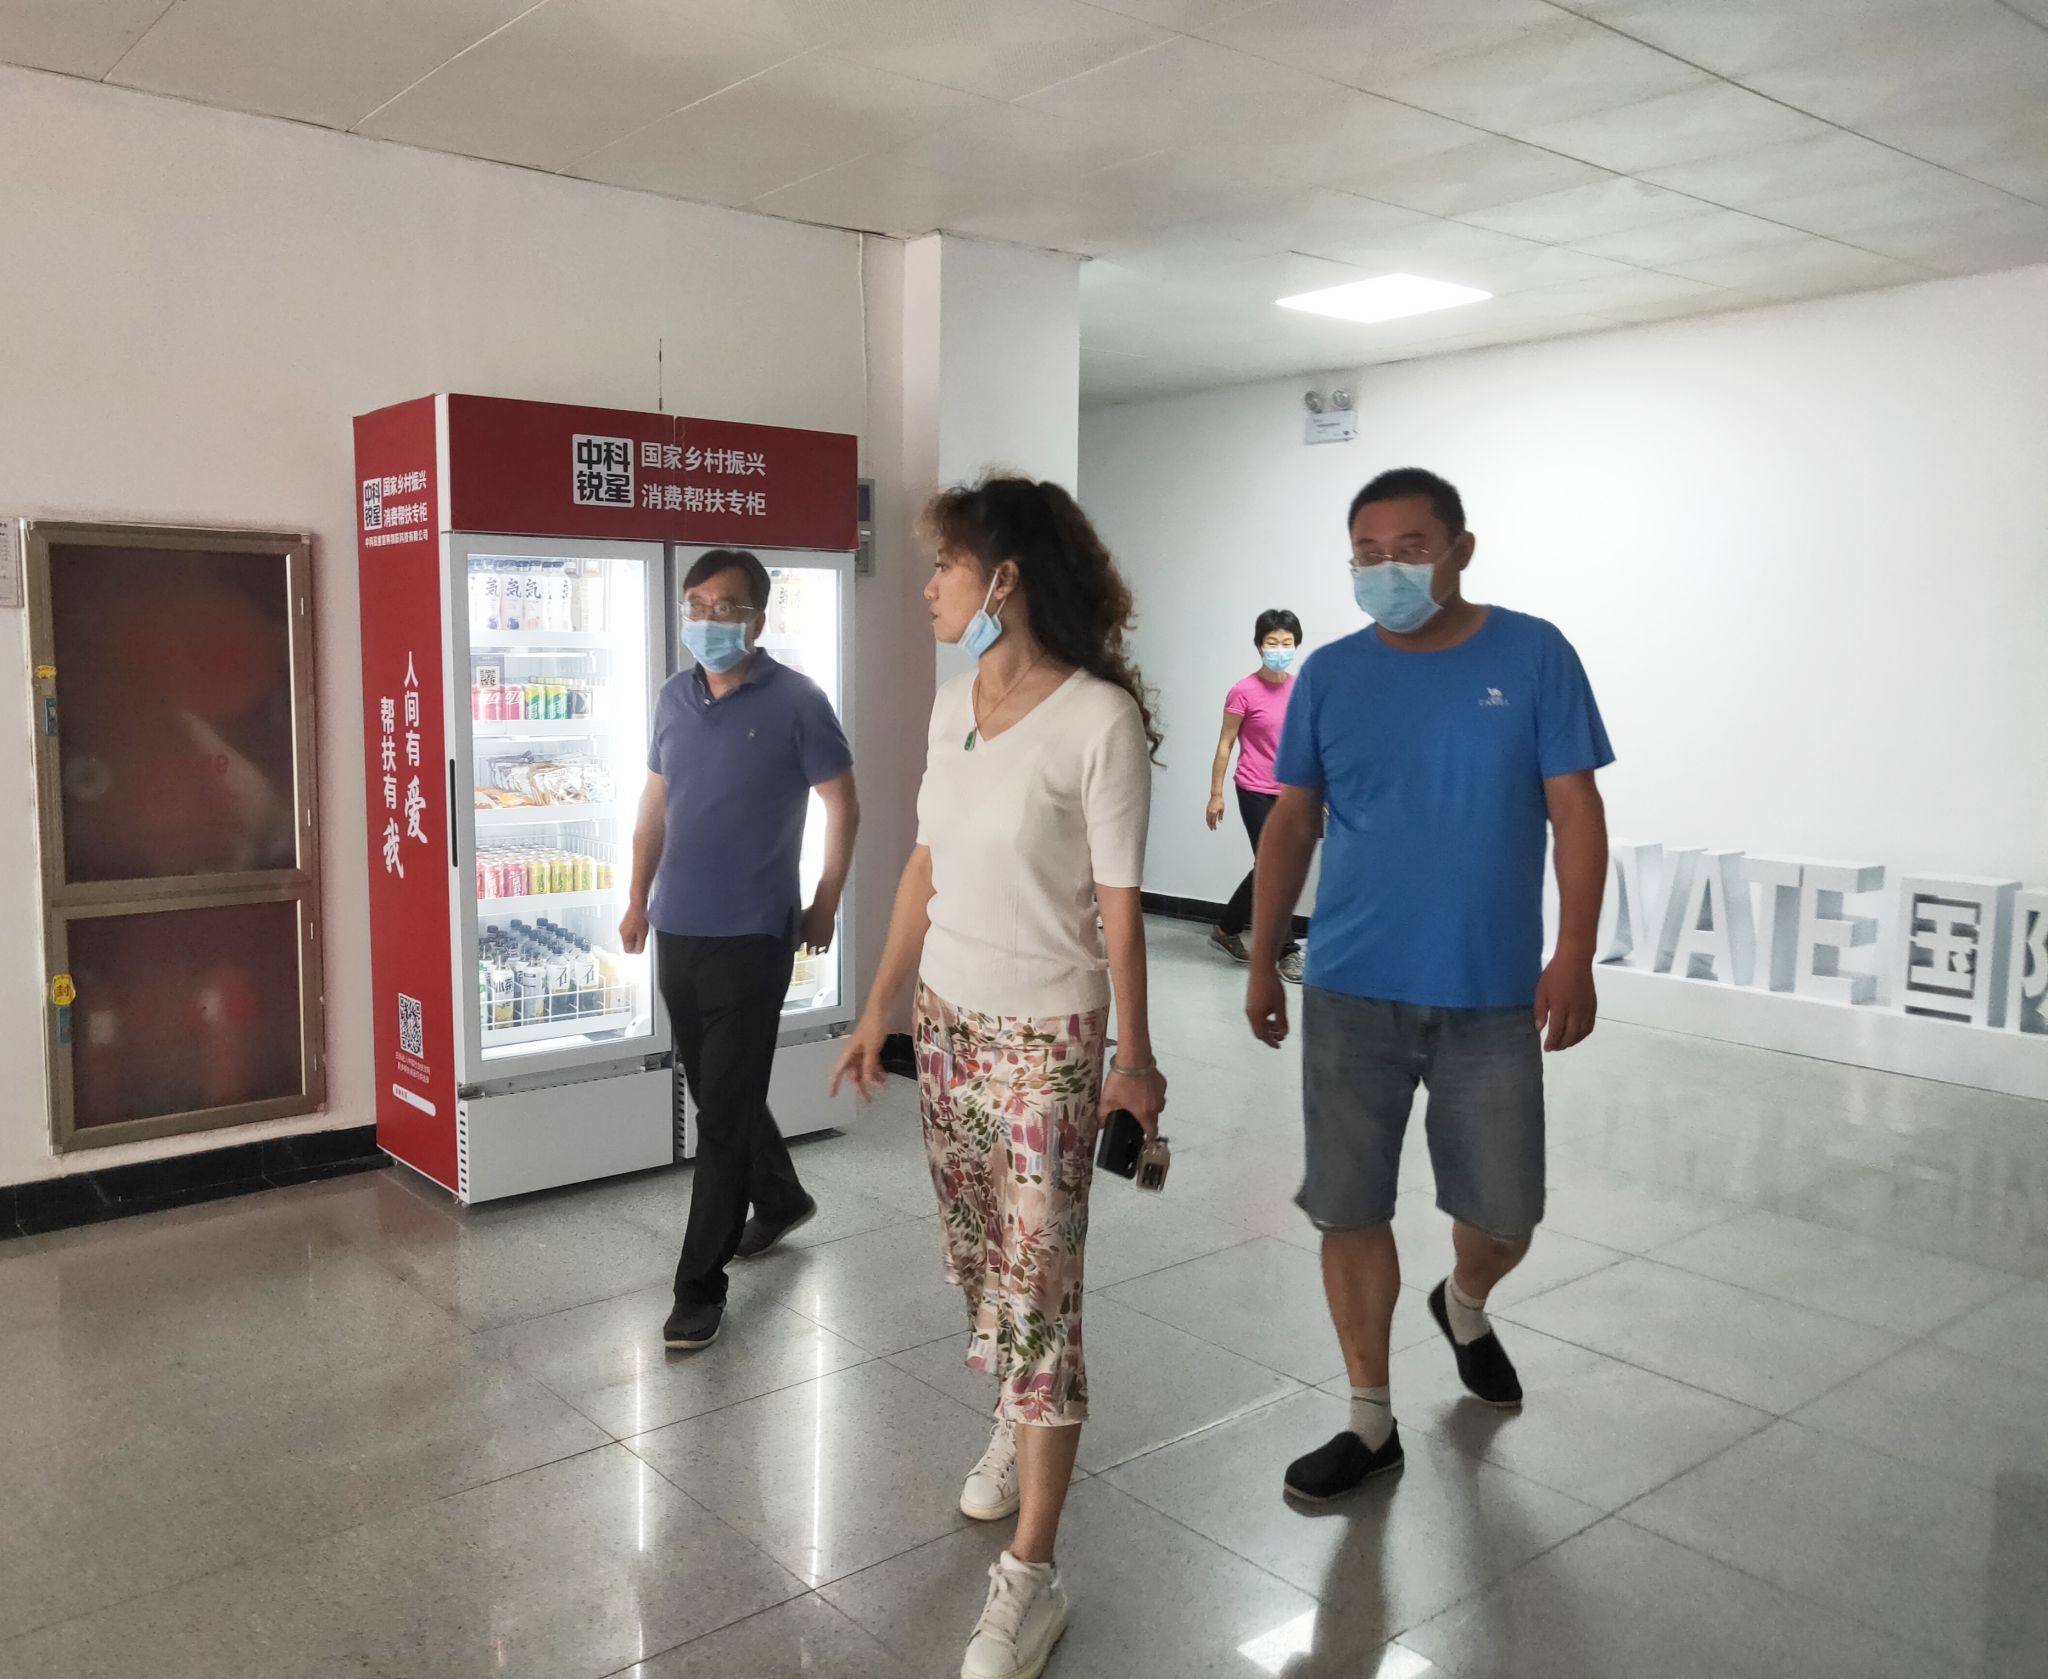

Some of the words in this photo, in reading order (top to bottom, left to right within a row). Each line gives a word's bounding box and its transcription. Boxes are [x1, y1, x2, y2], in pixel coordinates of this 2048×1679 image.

[577, 439, 630, 472] 中科
[641, 441, 766, 477] 国家乡村振兴
[383, 470, 426, 496] 国家乡村振兴
[577, 470, 632, 503] 锐星
[641, 483, 767, 516] 消费帮扶专柜
[384, 503, 427, 527] 消费帮扶专柜
[380, 695, 404, 879] 帮扶有我
